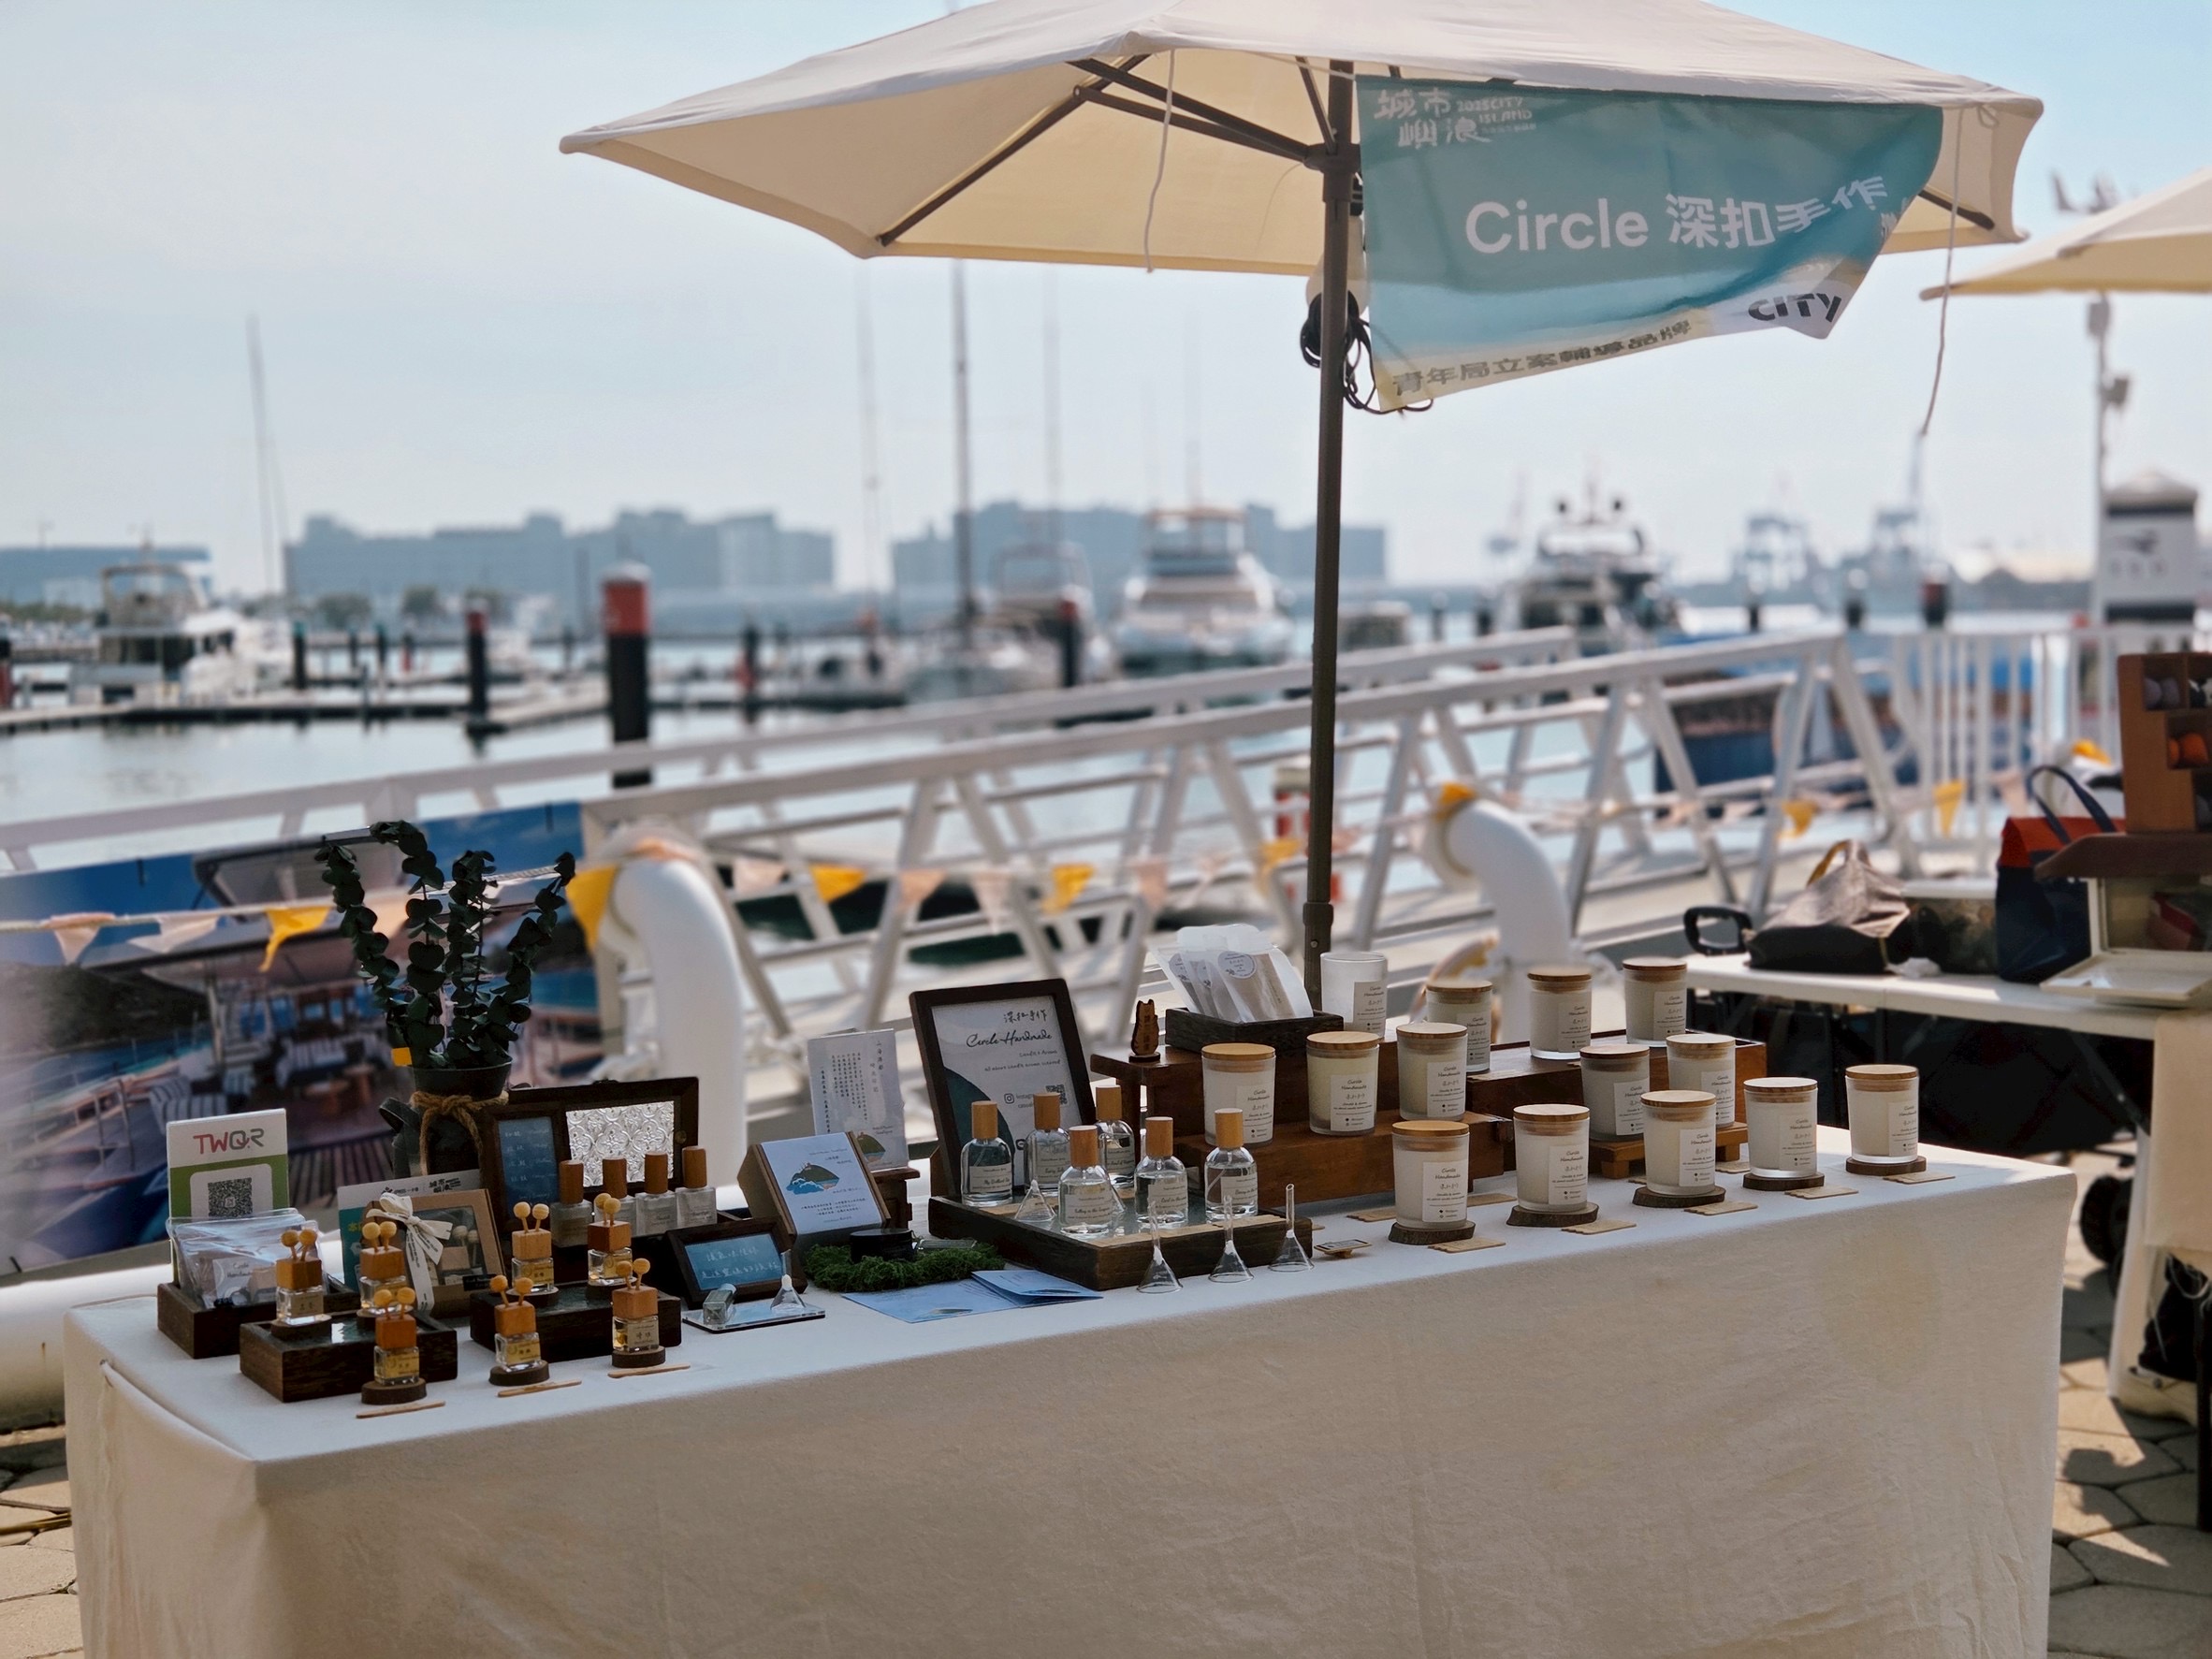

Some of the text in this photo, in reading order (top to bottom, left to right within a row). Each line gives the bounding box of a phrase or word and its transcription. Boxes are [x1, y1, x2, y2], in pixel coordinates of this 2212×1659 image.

[1465, 198, 1649, 255] Circle
[1665, 175, 1889, 250] 深扣手作
[1748, 292, 1842, 323] CITY
[966, 1029, 1052, 1048] Circle Handmade
[193, 1128, 265, 1155] TWQR
